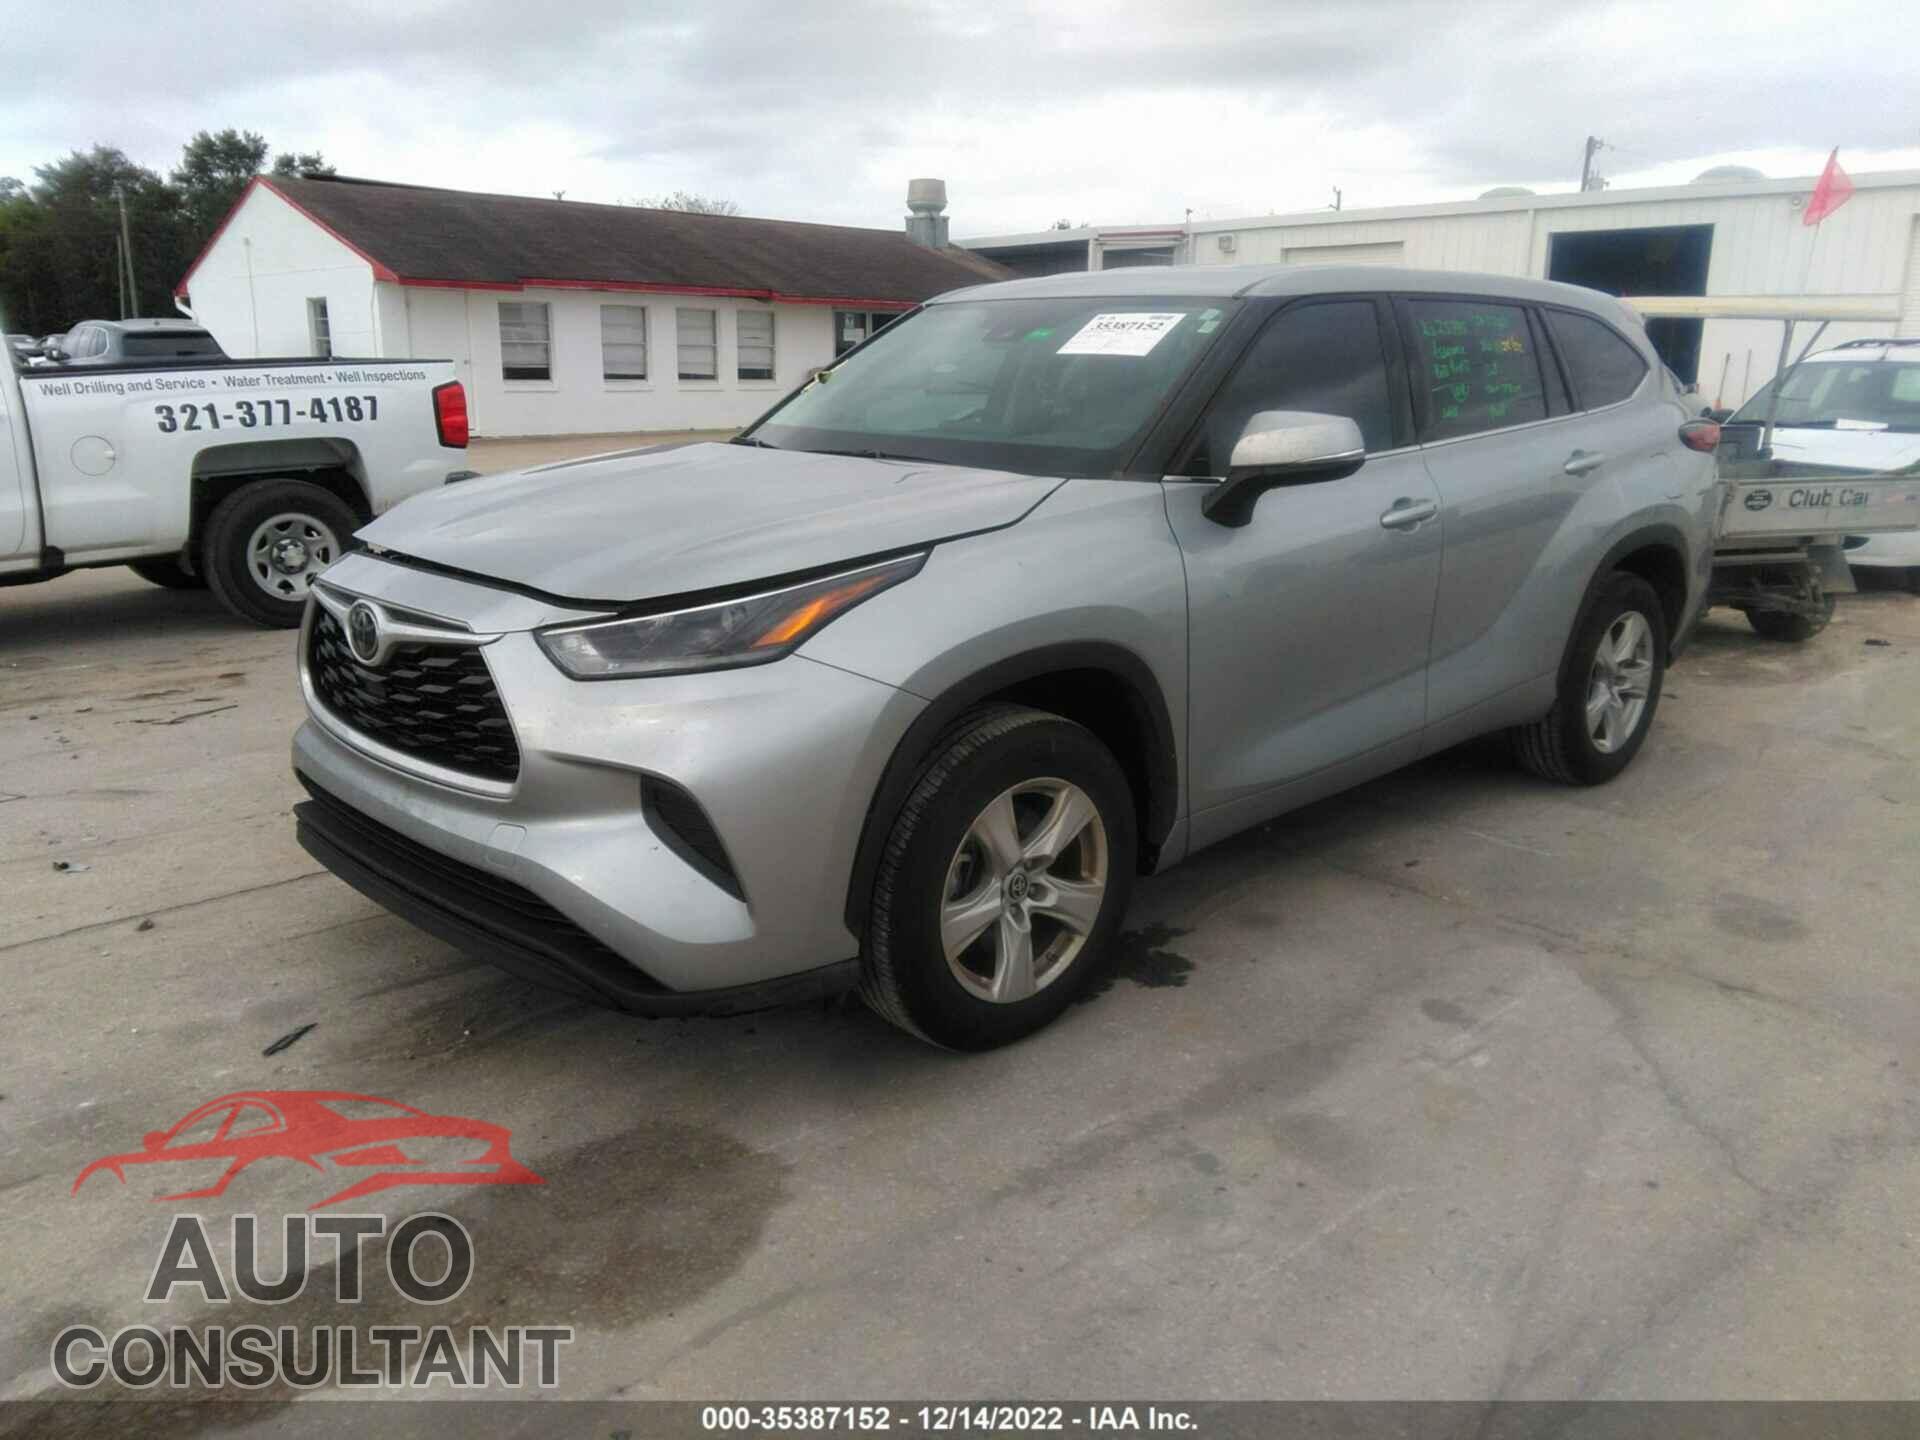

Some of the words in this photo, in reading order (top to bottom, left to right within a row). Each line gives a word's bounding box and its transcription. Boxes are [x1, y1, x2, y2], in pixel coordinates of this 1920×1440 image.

[39, 382, 71, 396] Well
[75, 380, 125, 396] Drilling
[128, 379, 152, 392] and
[155, 376, 206, 390] Service
[223, 375, 260, 387] Water
[264, 372, 325, 386] Treatment
[335, 370, 360, 383] Well
[363, 369, 426, 383] Inspections
[154, 395, 378, 433] 321-377-4187
[1790, 488, 1830, 508] Club
